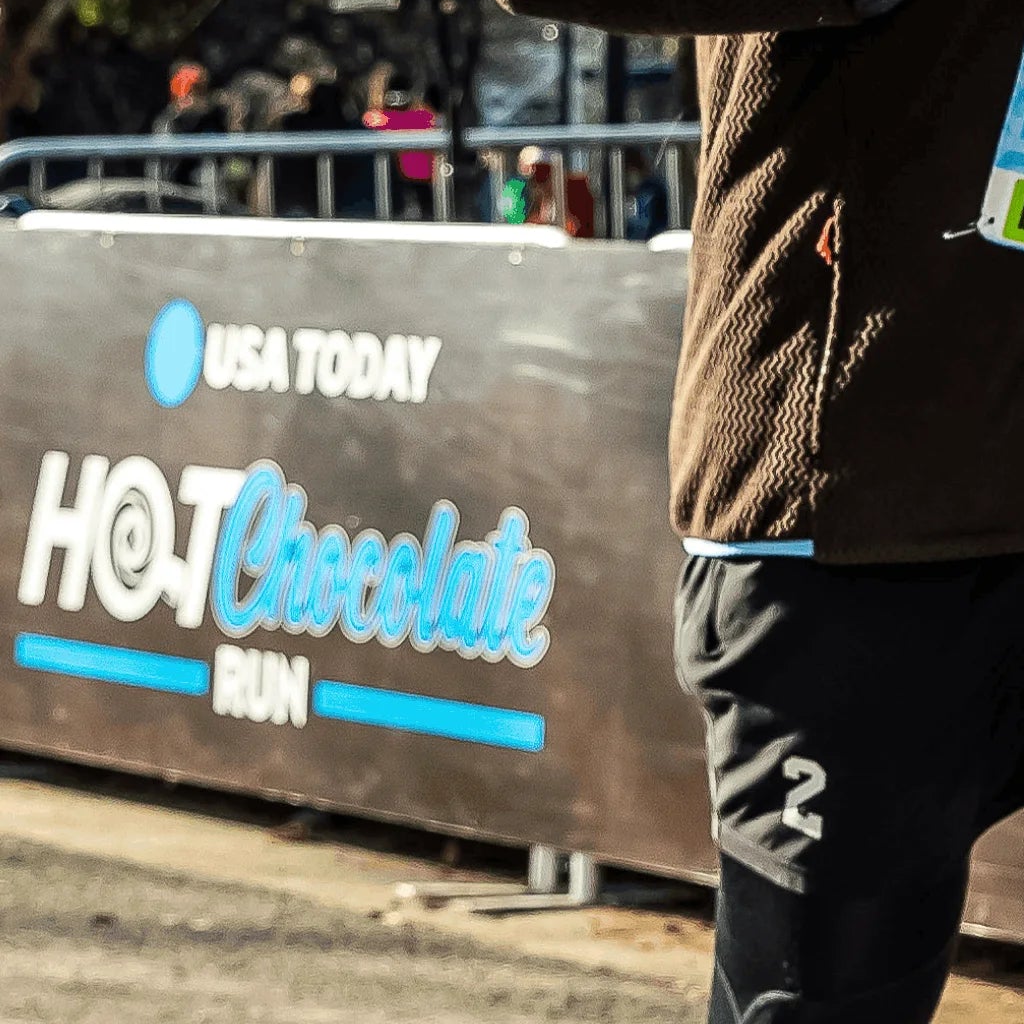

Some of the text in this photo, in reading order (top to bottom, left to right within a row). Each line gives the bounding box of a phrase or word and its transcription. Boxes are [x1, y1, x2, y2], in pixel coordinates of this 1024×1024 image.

[203, 322, 442, 403] USA TODAY
[17, 450, 556, 668] HOT Chocolate
[212, 644, 310, 728] RUN
[781, 754, 827, 840] 2
